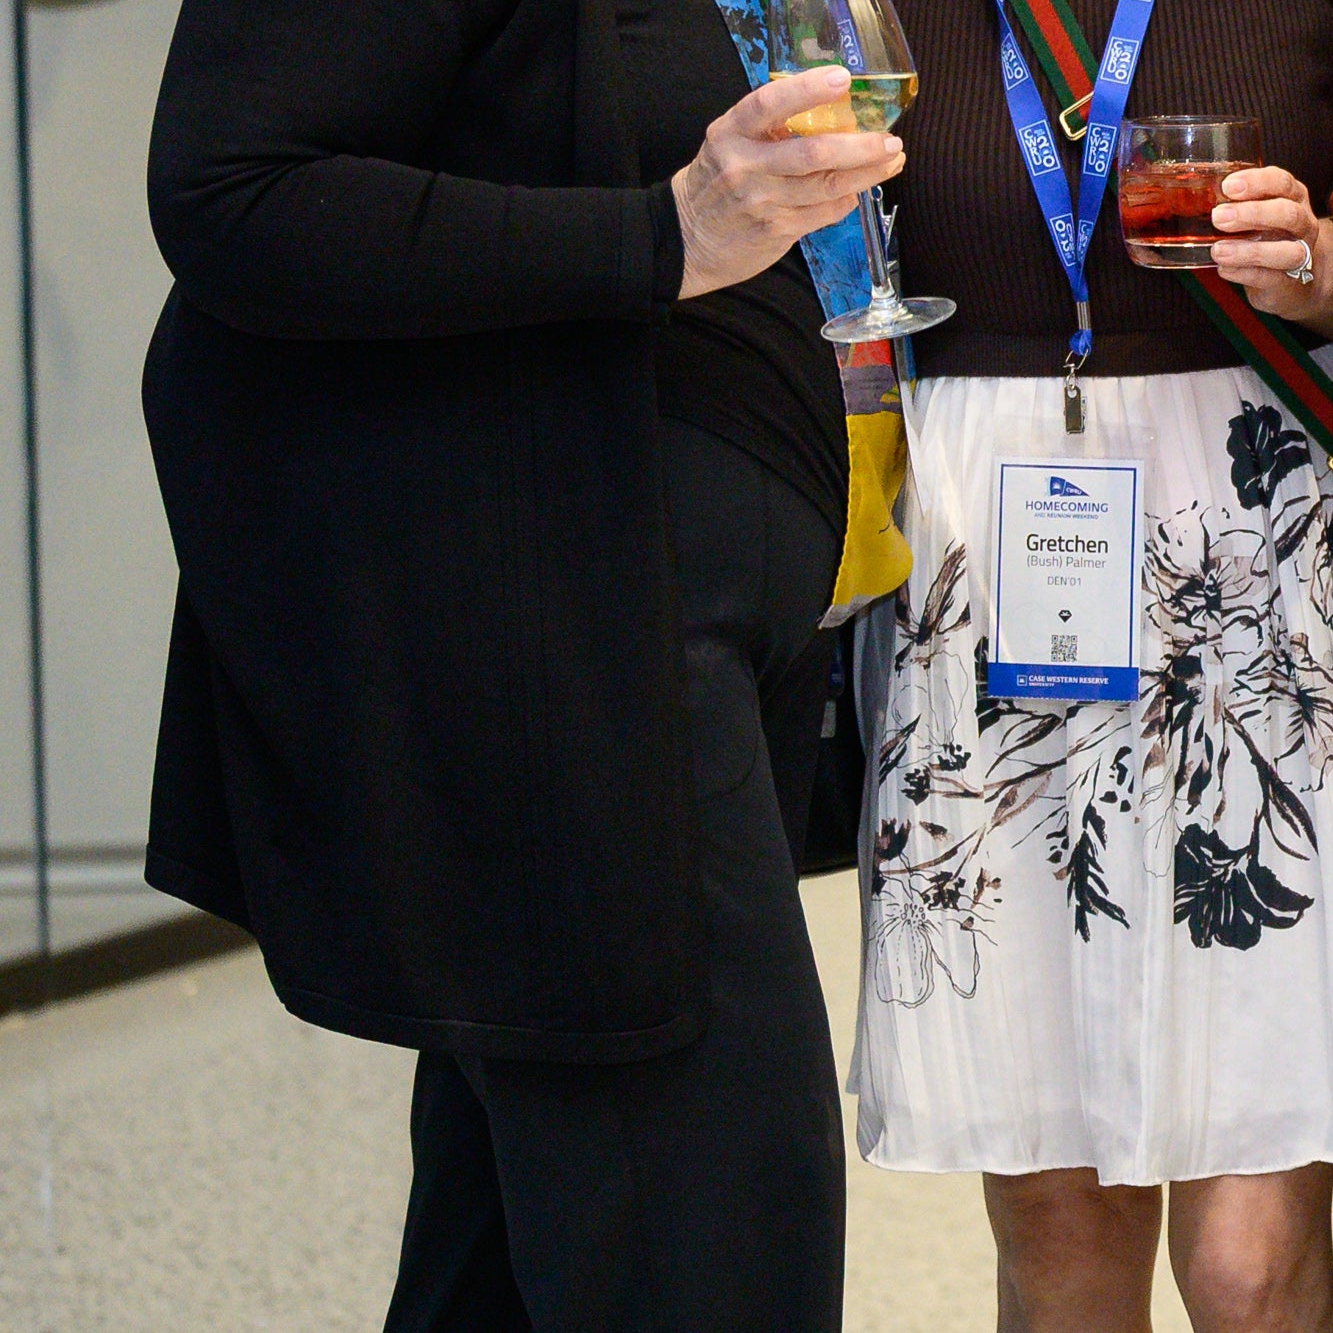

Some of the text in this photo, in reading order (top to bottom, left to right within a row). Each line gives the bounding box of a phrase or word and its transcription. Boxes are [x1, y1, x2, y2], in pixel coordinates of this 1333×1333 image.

[1107, 41, 1123, 73] CWRU
[1024, 128, 1042, 166] CWRU
[1088, 127, 1101, 166] CWRU
[1026, 500, 1108, 512] HOMECOMING
[1026, 534, 1109, 554] Gretchen
[1026, 555, 1107, 569] (Bush) Palmer
[1046, 676, 1078, 684] WESTERN
